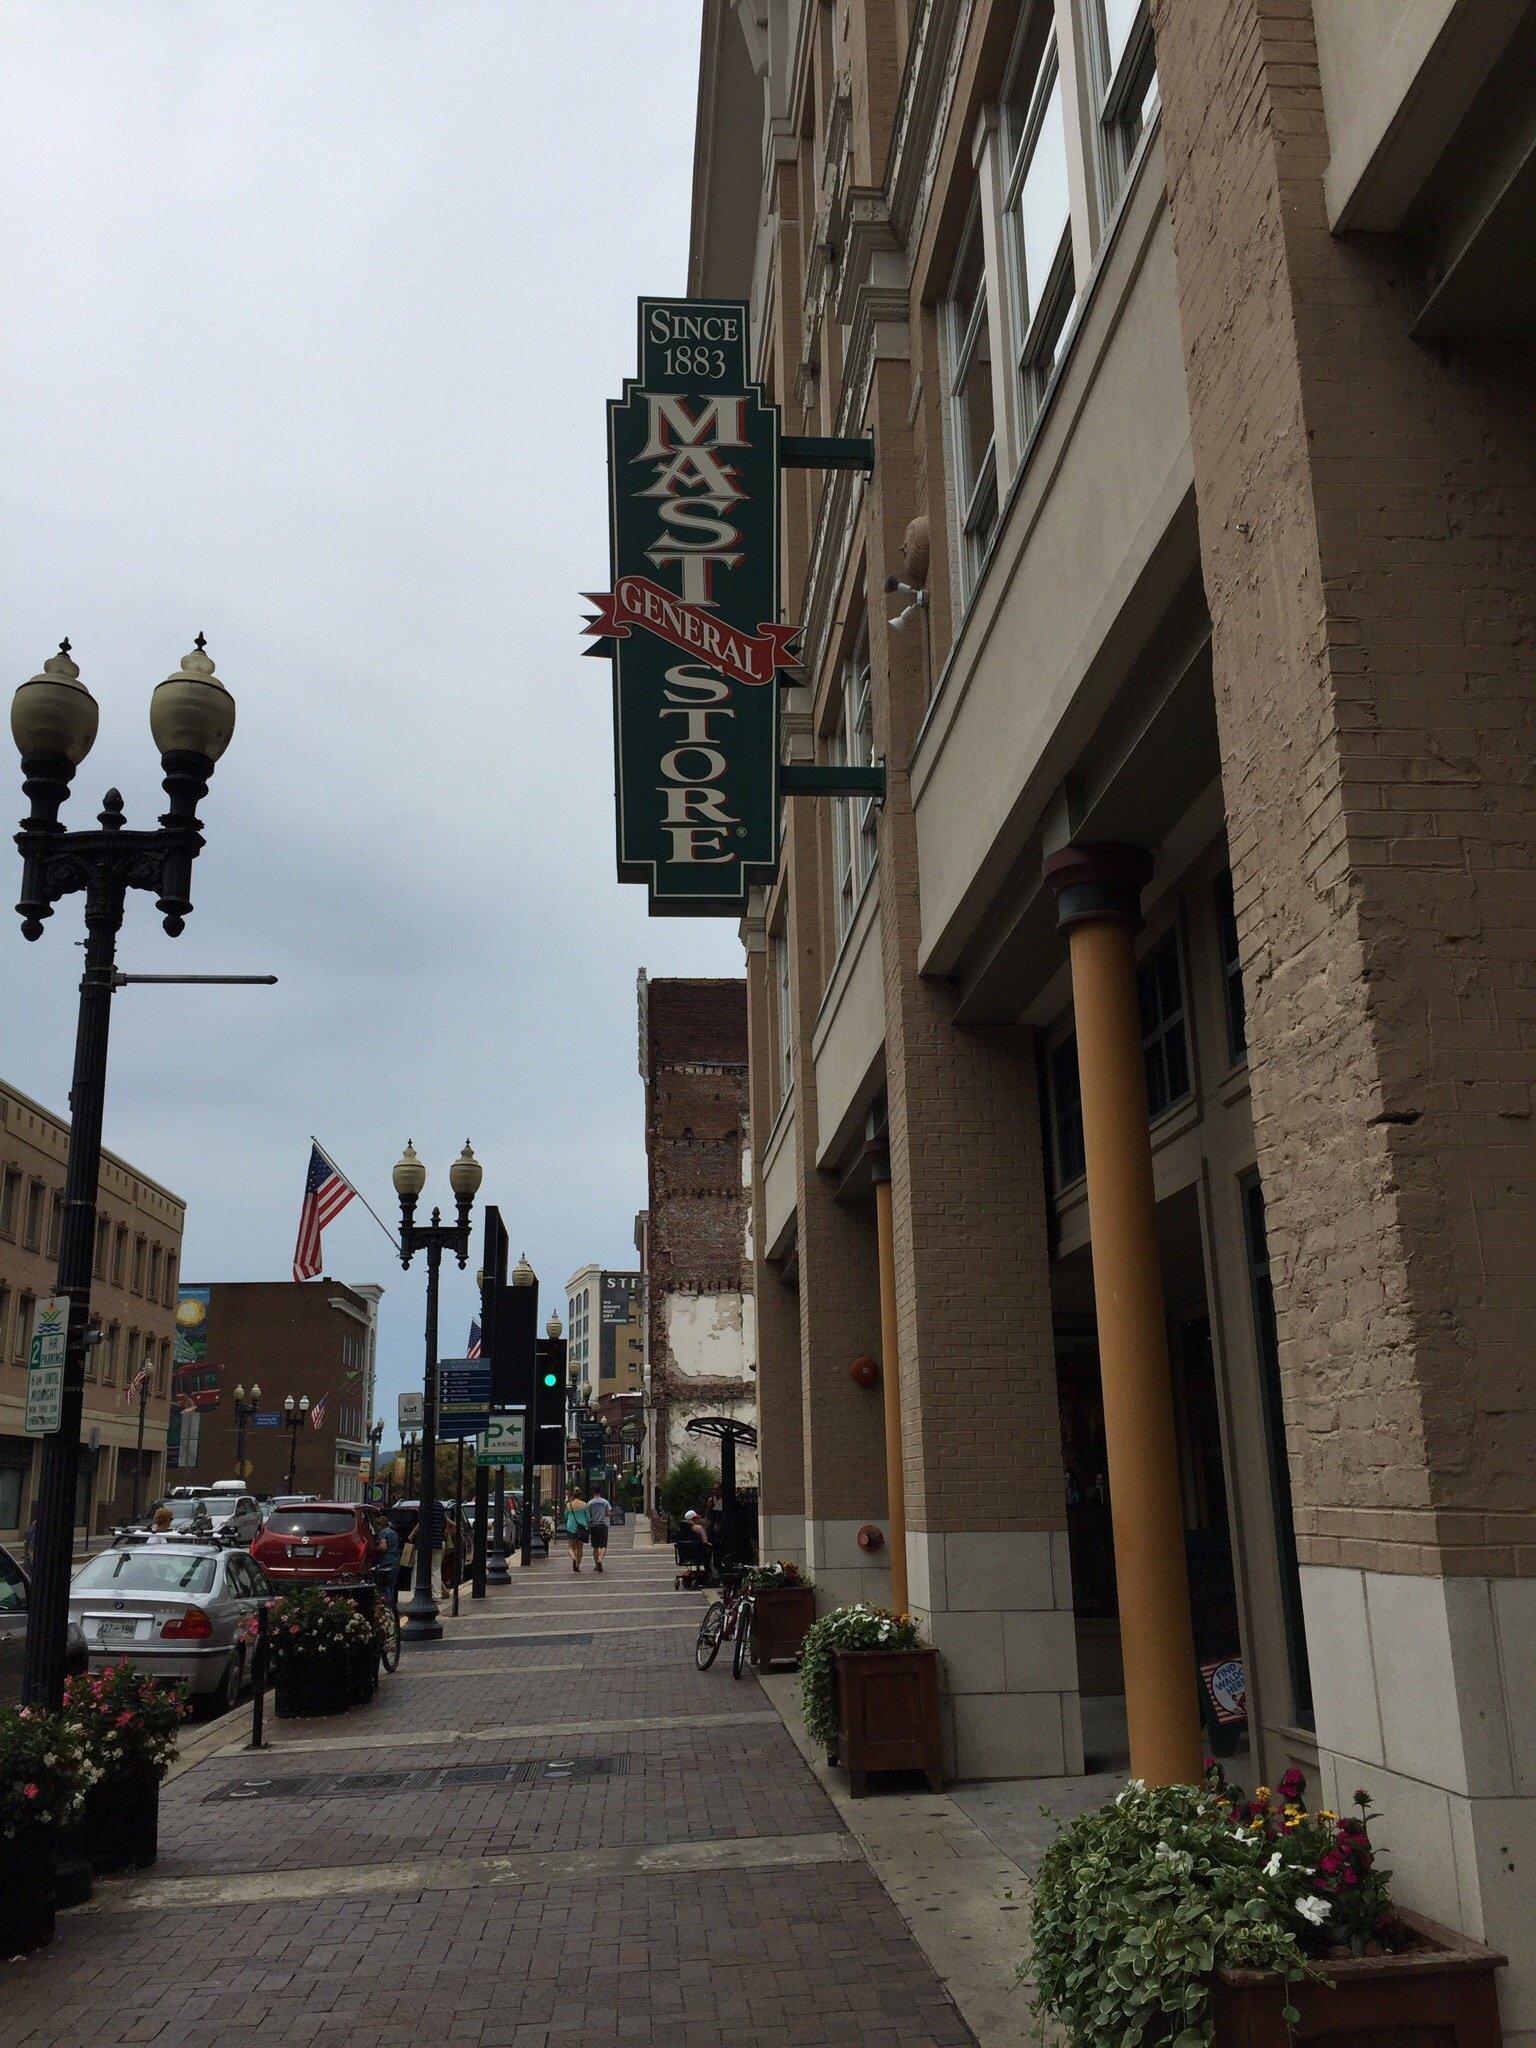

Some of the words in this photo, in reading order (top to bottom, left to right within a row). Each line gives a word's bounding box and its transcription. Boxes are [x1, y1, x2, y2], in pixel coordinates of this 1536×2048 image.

[650, 308, 739, 345] SINCE
[663, 346, 726, 379] 1883
[628, 391, 753, 607] MAST
[620, 581, 763, 680] GENERAL
[655, 664, 741, 863] STORE
[31, 1341, 40, 1364] 2
[41, 1352, 63, 1366] PARKING
[1216, 1663, 1236, 1679] FIND
